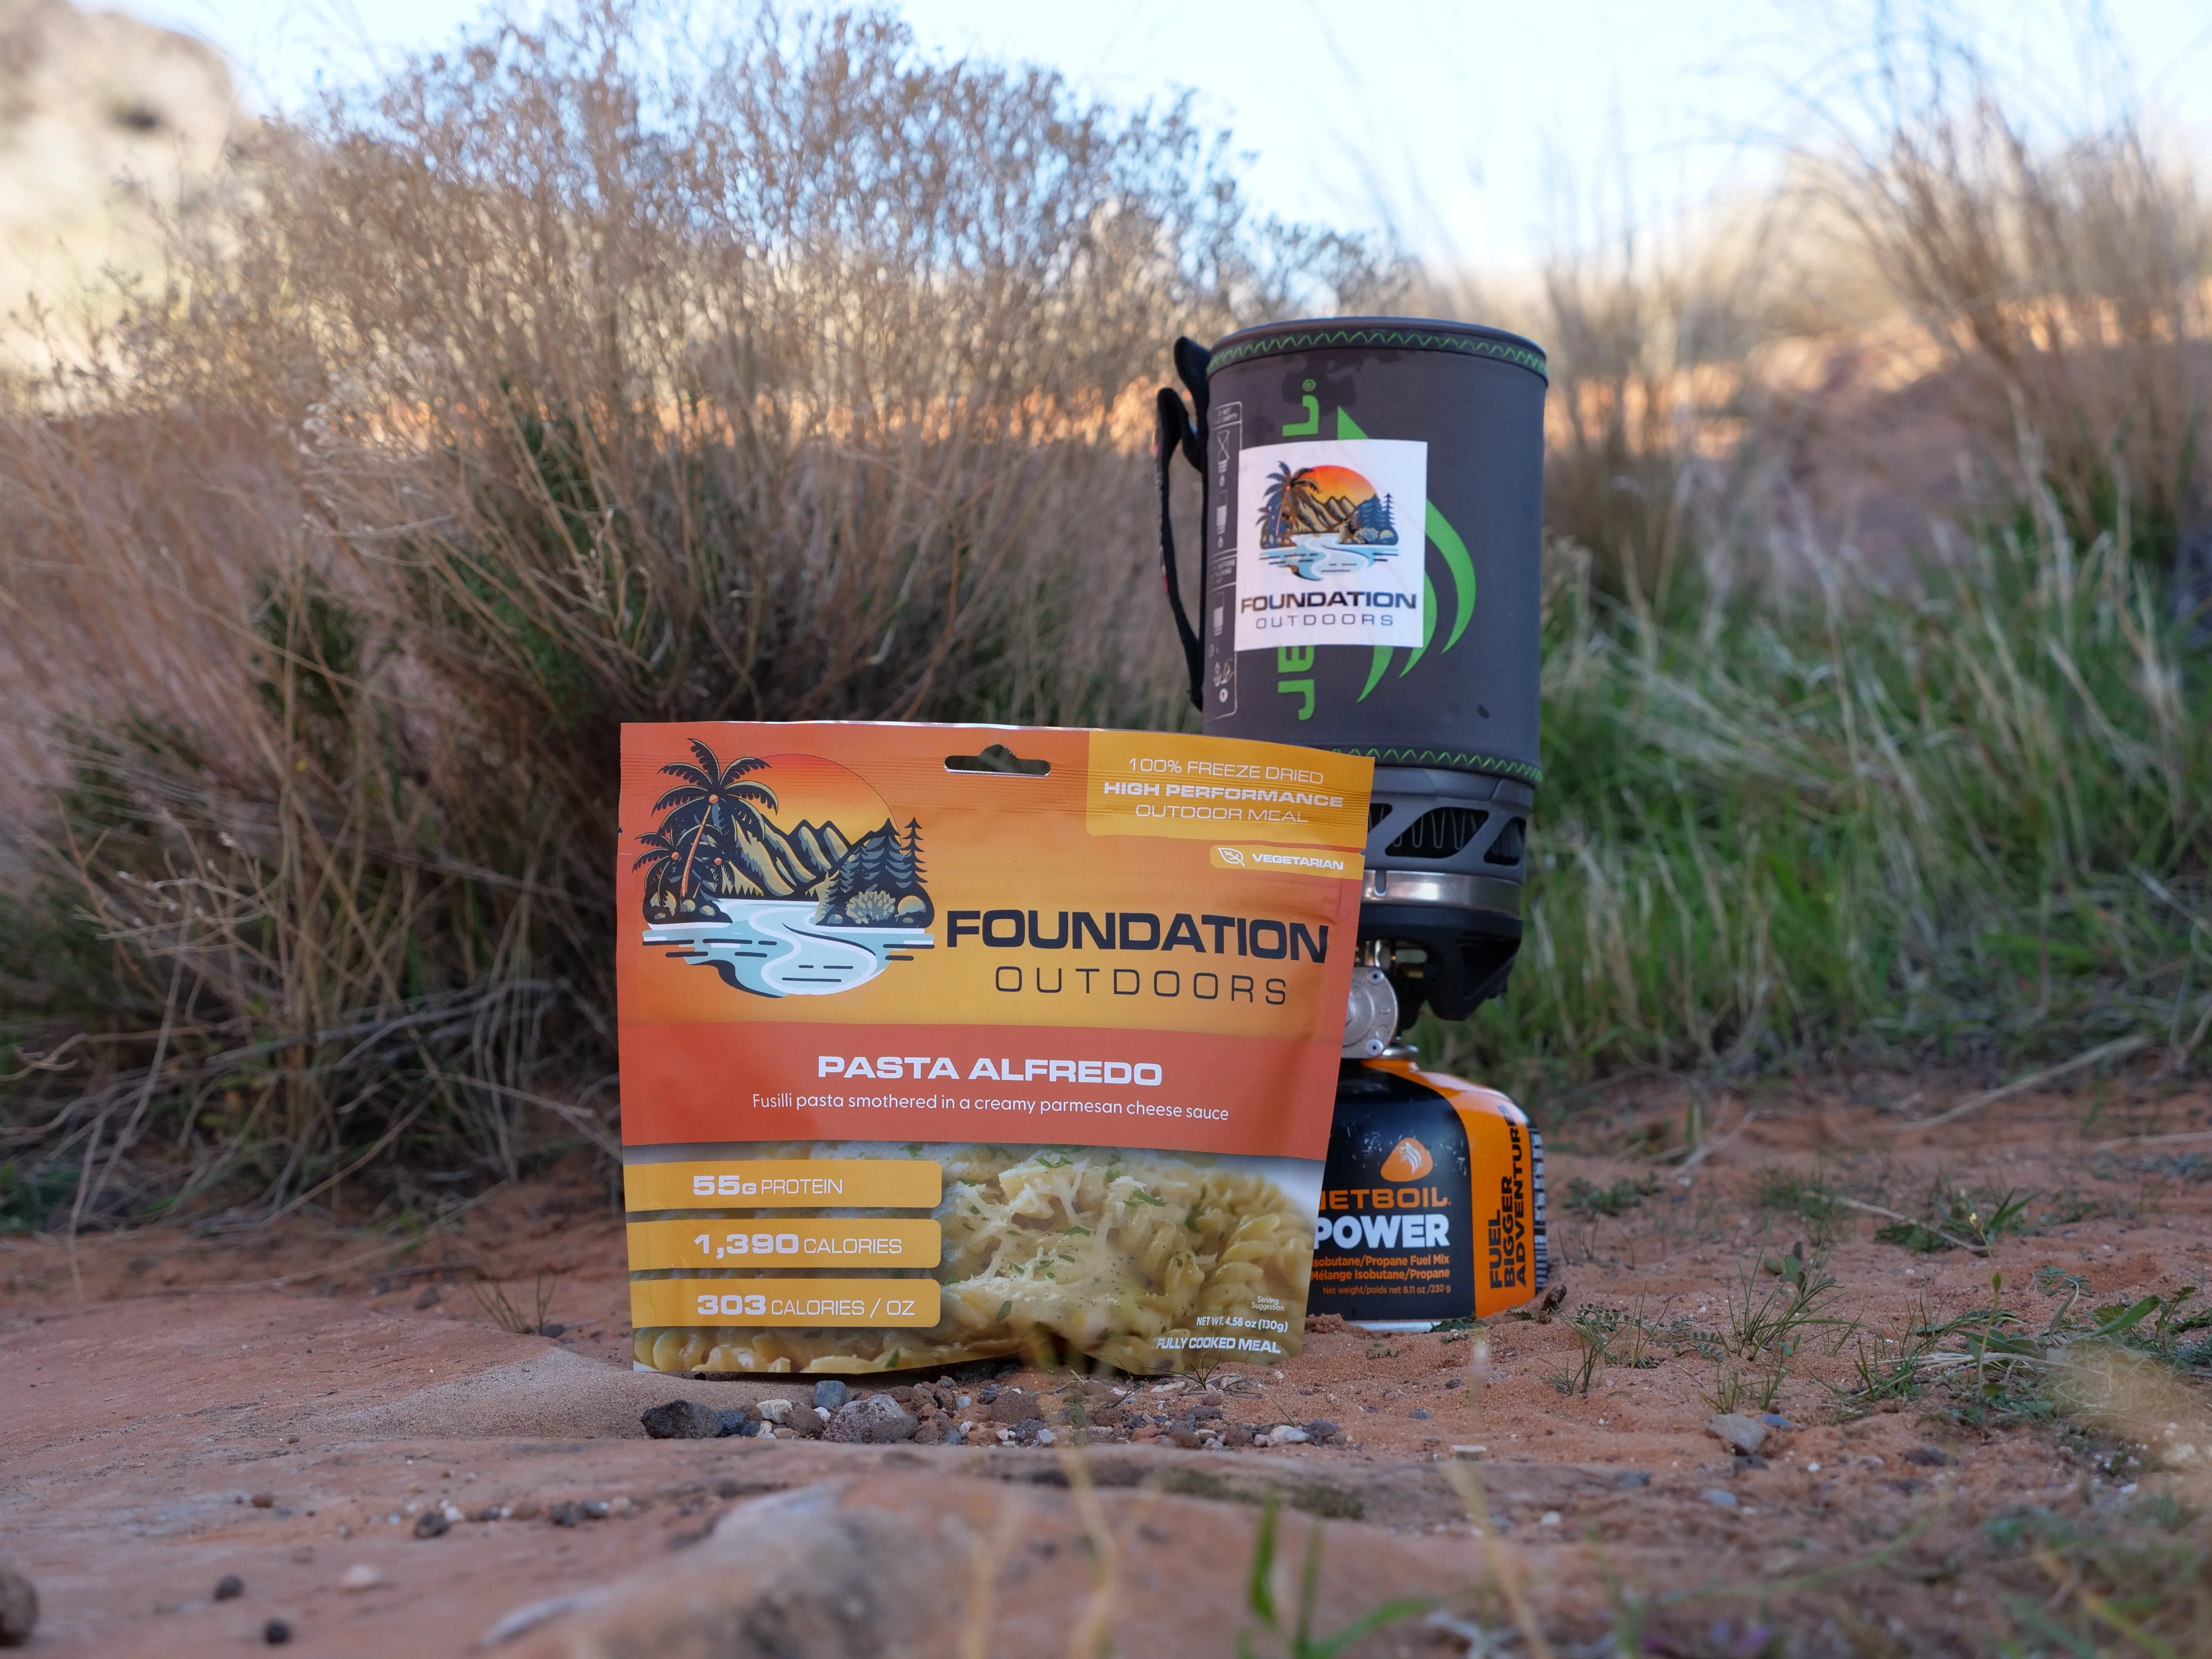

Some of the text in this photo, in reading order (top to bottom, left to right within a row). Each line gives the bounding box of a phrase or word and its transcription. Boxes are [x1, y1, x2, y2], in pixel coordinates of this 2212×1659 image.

[1241, 591, 1417, 613] FOUNDATION
[1256, 614, 1393, 629] OUTDOORS
[1129, 758, 1323, 784] 100% FREEZE DRIED
[1104, 782, 1343, 807] HIGH PERFORMANCE
[1135, 804, 1308, 823] OUTDOOR MEAL
[1252, 853, 1344, 870] VEGETARIAN
[947, 909, 1329, 964] FOUNDATION
[995, 966, 1286, 1005] OUTDOORS
[818, 1056, 1162, 1086] PASTA ALFREDO
[753, 1093, 1229, 1121] Fusilli pasta smothered in a creamy parmesan cheese sauce
[761, 1179, 843, 1194] PROTEIN
[1497, 1104, 1526, 1288] ADVENTURES
[1314, 1214, 1450, 1250] POWER
[1501, 1176, 1515, 1287] BIGGER
[694, 1234, 902, 1259] 1,390 CALORIES
[1488, 1209, 1502, 1289] FUEL
[1410, 1254, 1431, 1266] Fuel
[1433, 1253, 1450, 1265] Mix
[1311, 1268, 1450, 1282] Mélange Isobutane/Propane
[1257, 1296, 1279, 1305] Serving
[1323, 1286, 1336, 1295] Net
[1389, 1286, 1401, 1294] net
[697, 1295, 915, 1318] 303 CALORIES / OZ
[1251, 1302, 1284, 1311] Suggestion
[1196, 1316, 1211, 1326] NET
[1212, 1316, 1224, 1326] WT.
[1225, 1317, 1243, 1327] 4.58
[1258, 1319, 1288, 1333] (130g)
[1156, 1337, 1281, 1354] FULLY COOKED MEAL
